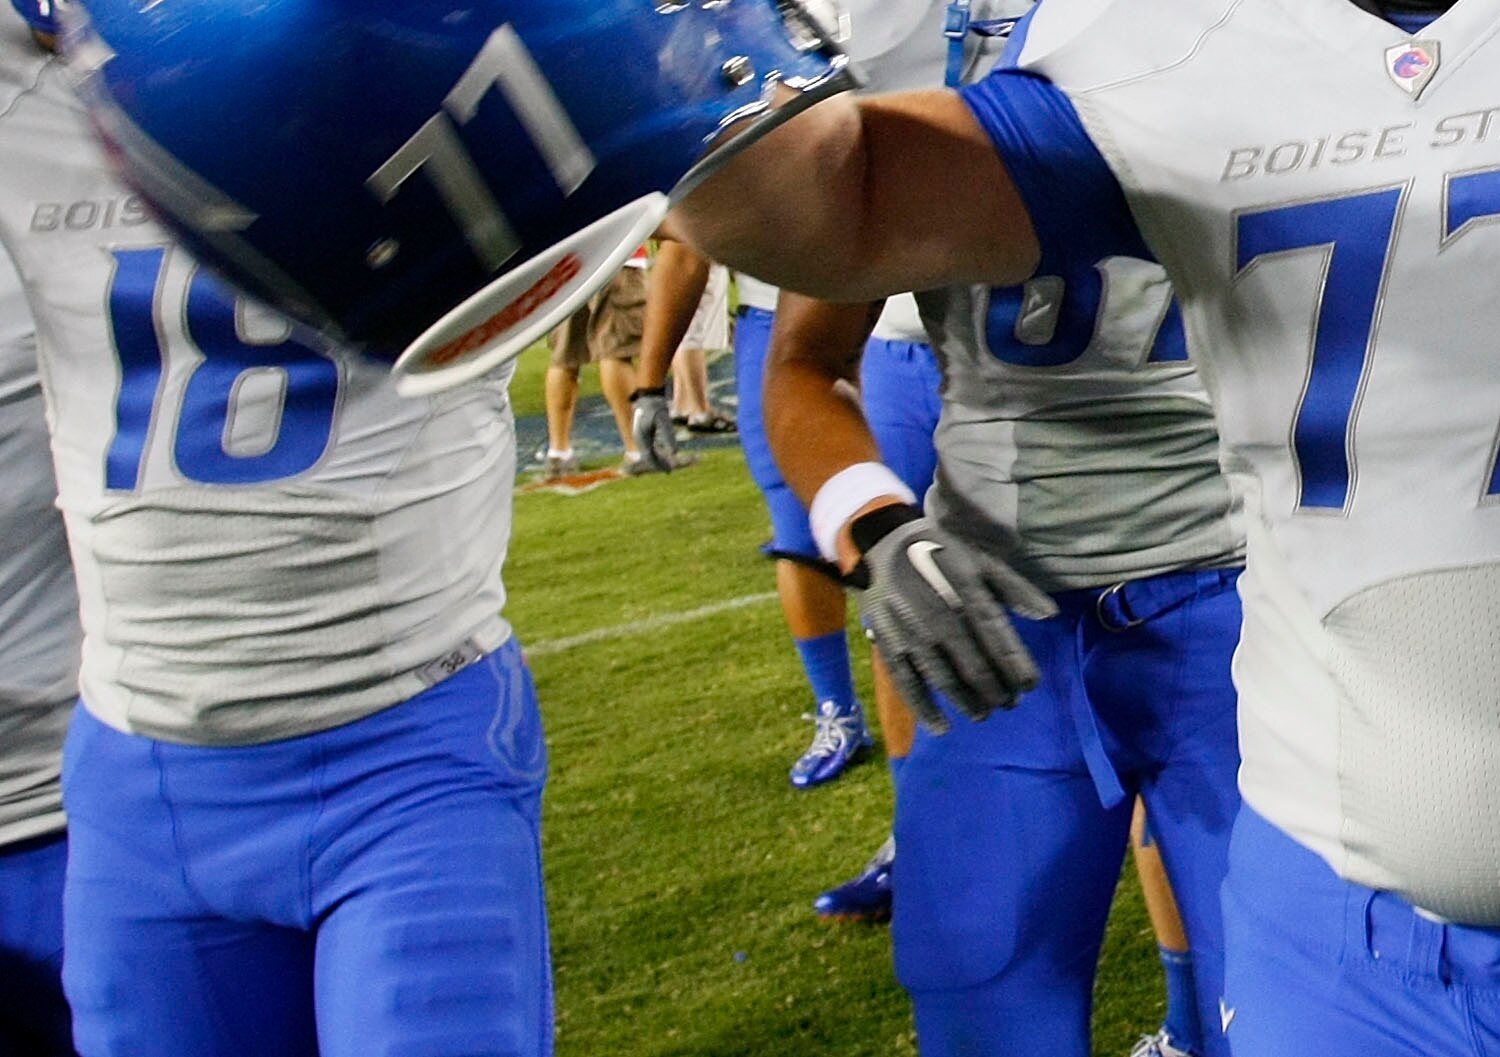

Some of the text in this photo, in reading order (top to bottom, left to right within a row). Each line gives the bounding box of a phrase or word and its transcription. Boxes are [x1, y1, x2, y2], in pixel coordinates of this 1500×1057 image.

[28, 196, 155, 234] BOIS
[364, 20, 598, 276] 77
[1219, 121, 1416, 183] BOISE
[97, 242, 350, 494] 18
